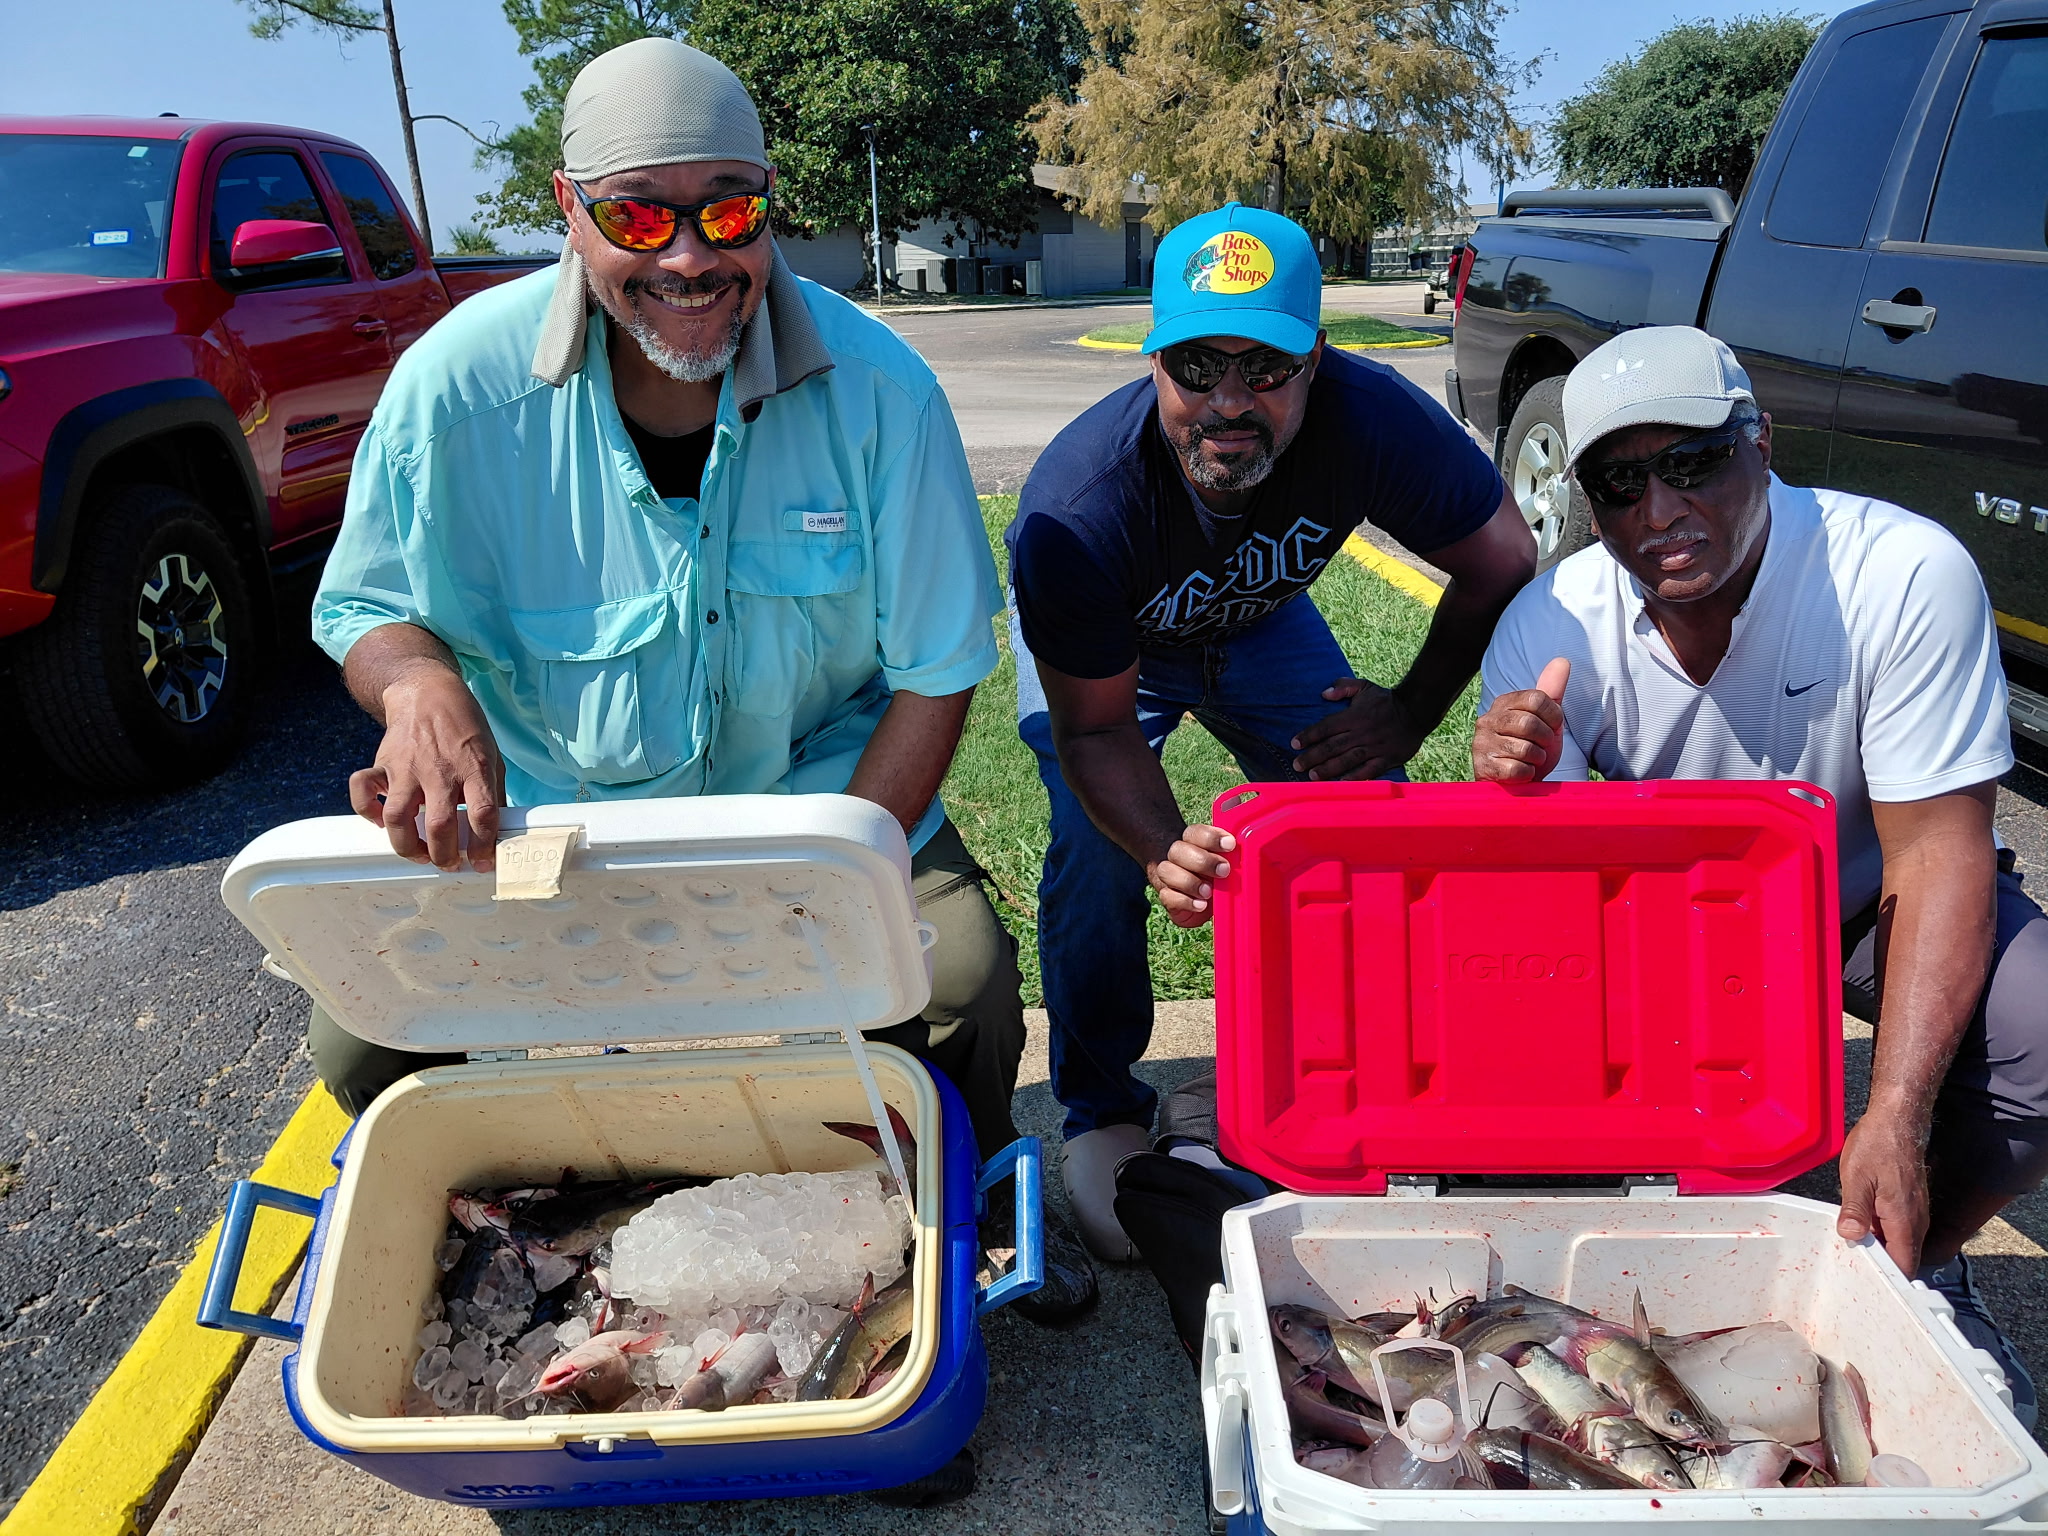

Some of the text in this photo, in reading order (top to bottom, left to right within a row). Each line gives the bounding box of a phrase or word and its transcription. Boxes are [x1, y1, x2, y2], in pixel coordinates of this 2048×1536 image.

[1222, 233, 1259, 251] Bass
[1223, 250, 1250, 266] Pro
[1222, 266, 1268, 286] Shops
[1974, 491, 2022, 525] V8
[816, 516, 845, 526] MAGELLAN
[1448, 953, 1596, 982] IGLOO
